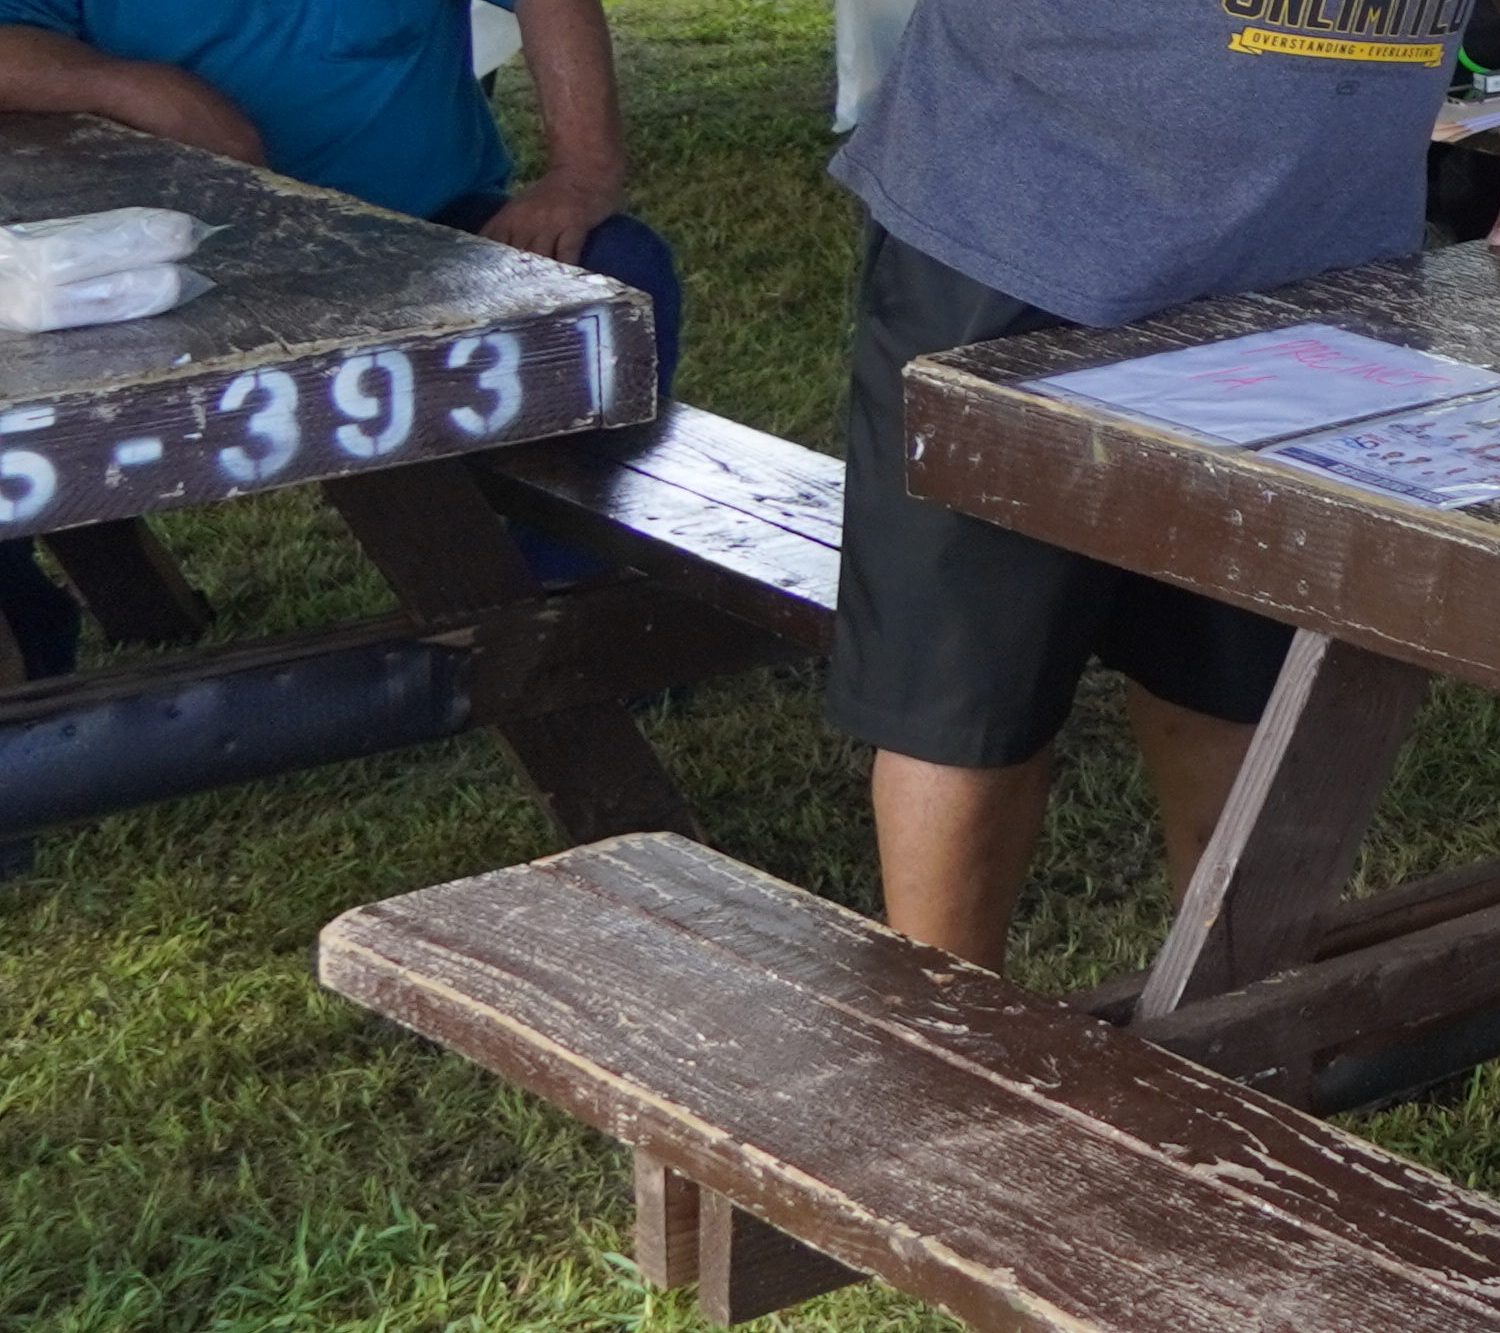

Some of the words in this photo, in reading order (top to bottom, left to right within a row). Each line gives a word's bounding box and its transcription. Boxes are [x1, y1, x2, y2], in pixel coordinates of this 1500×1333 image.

[1252, 32, 1355, 56] OVERSTANDING
[1368, 45, 1436, 58] EVERLASTING
[1241, 339, 1452, 389] PRECINCT
